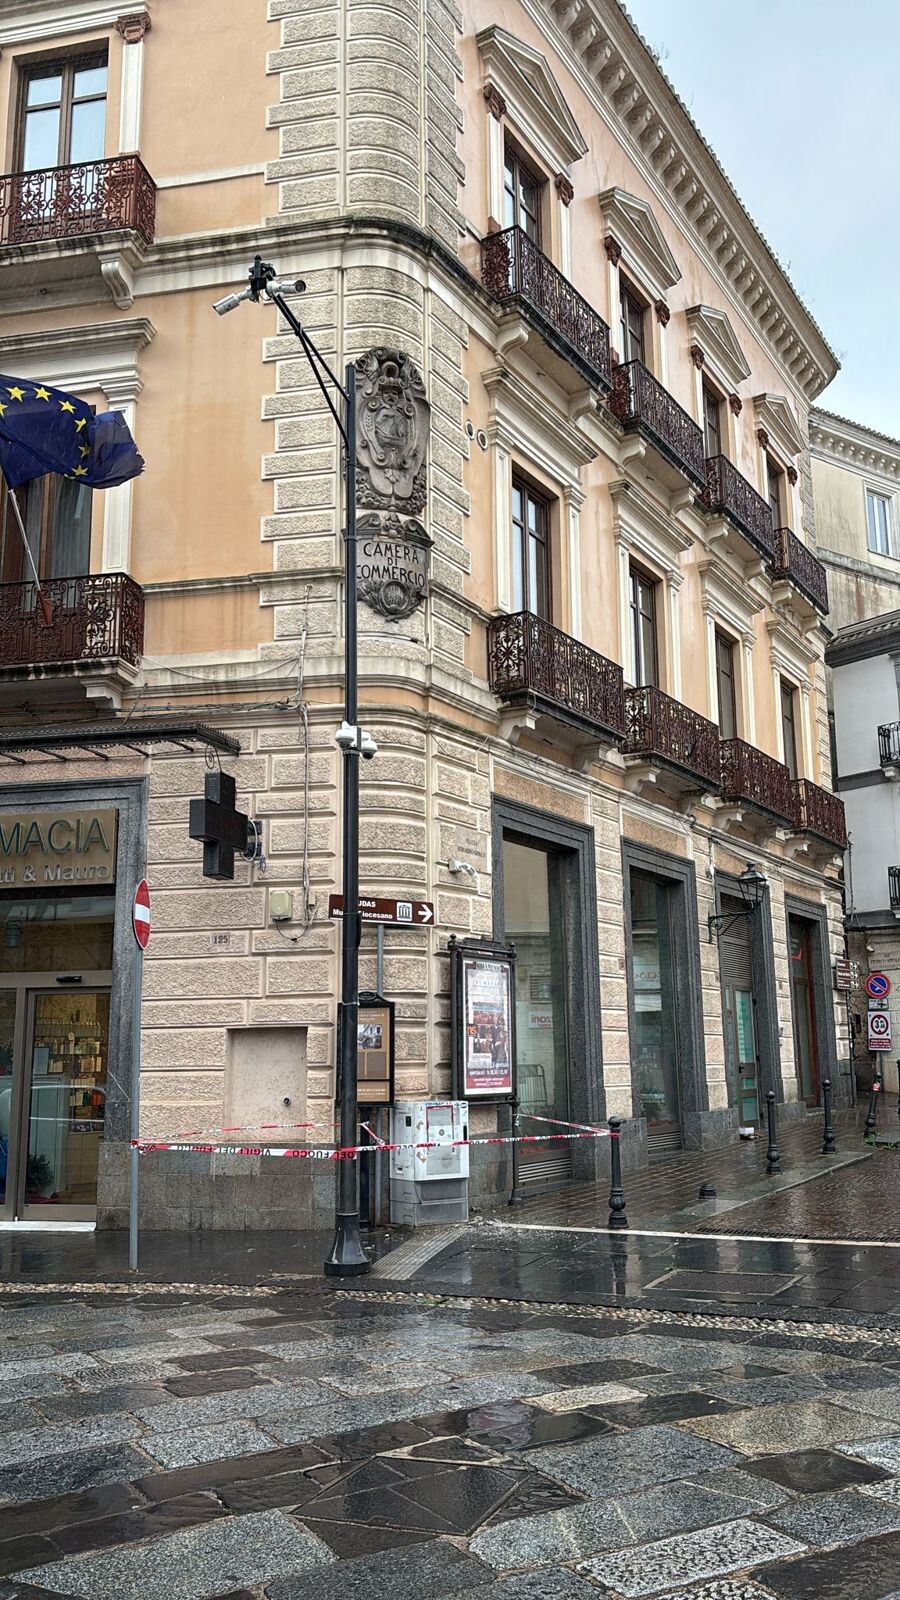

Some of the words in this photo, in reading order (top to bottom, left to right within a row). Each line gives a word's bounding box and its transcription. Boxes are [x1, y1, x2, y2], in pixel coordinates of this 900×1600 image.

[363, 542, 419, 564] CAMERA
[387, 557, 398, 566] DI
[23, 864, 37, 882] &
[44, 864, 110, 882] Mauro
[358, 900, 376, 908] UDAS
[358, 910, 393, 920] iocesano
[213, 936, 228, 944] 125
[241, 1146, 271, 1156] VIGILI
[292, 1150, 329, 1159] FUOCO
[334, 1150, 354, 1159] DEL
